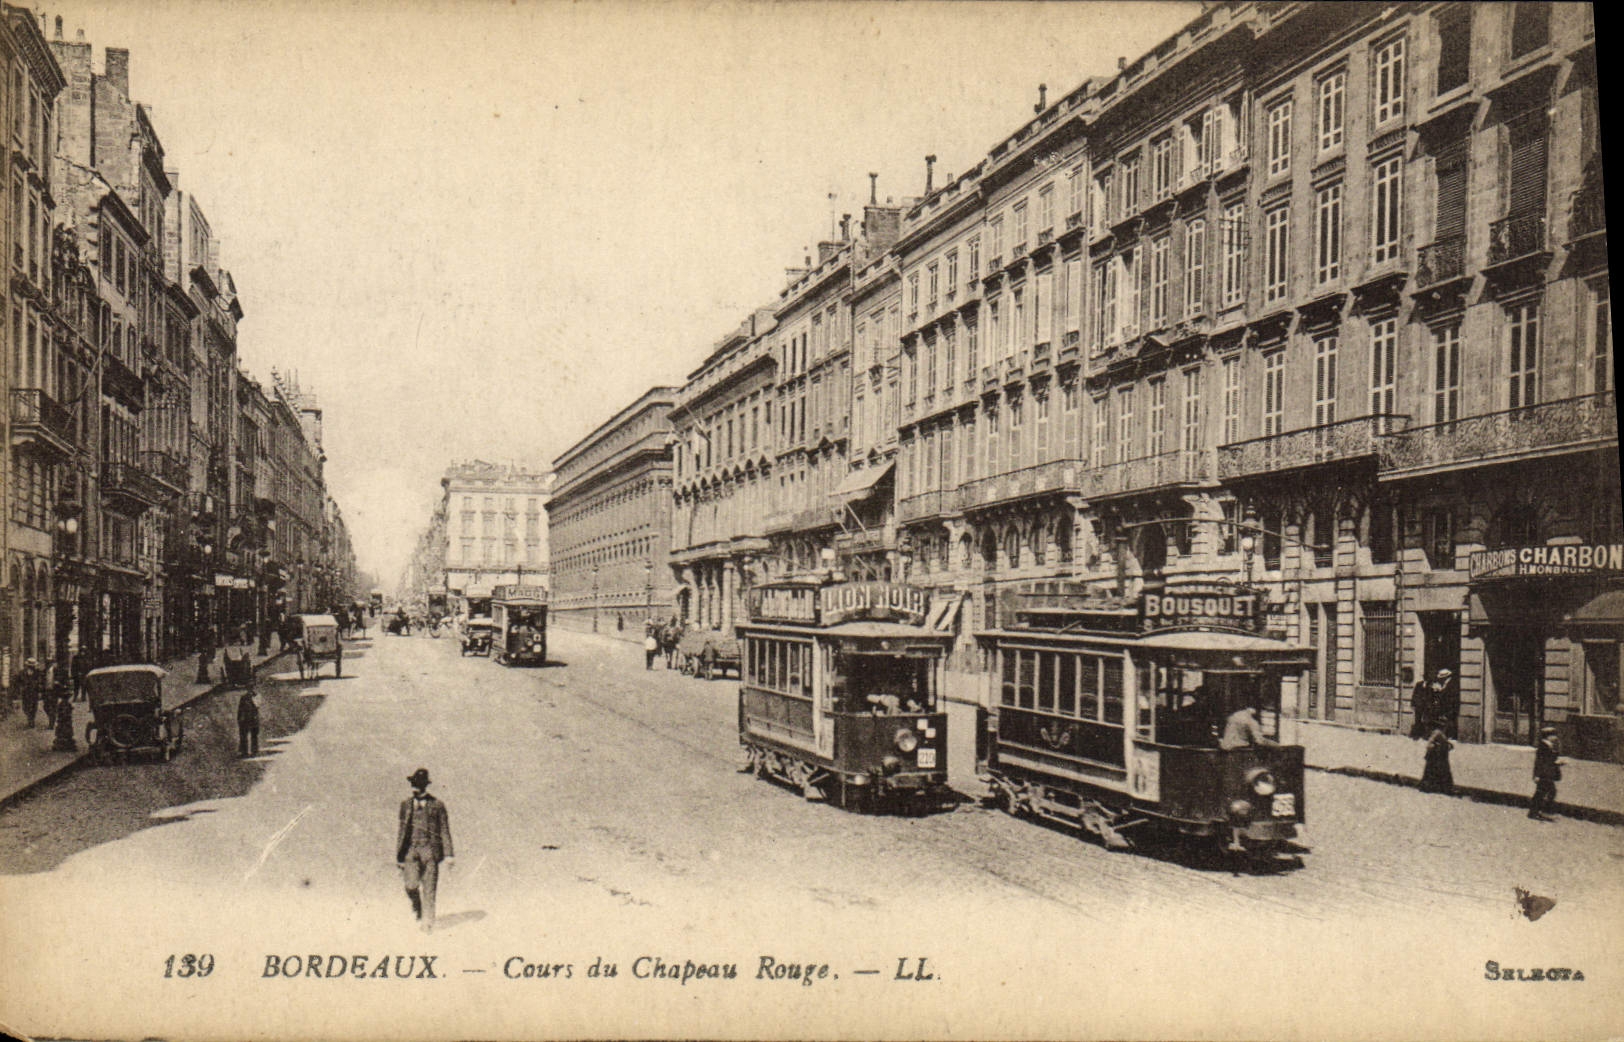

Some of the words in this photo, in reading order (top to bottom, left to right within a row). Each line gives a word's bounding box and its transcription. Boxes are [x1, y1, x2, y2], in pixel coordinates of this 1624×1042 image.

[1470, 549, 1517, 577] CHARBONS
[1519, 544, 1623, 570] CHARBON
[825, 584, 870, 615] LION
[875, 584, 925, 616] NOIR
[1145, 595, 1257, 617] BOUSQUET
